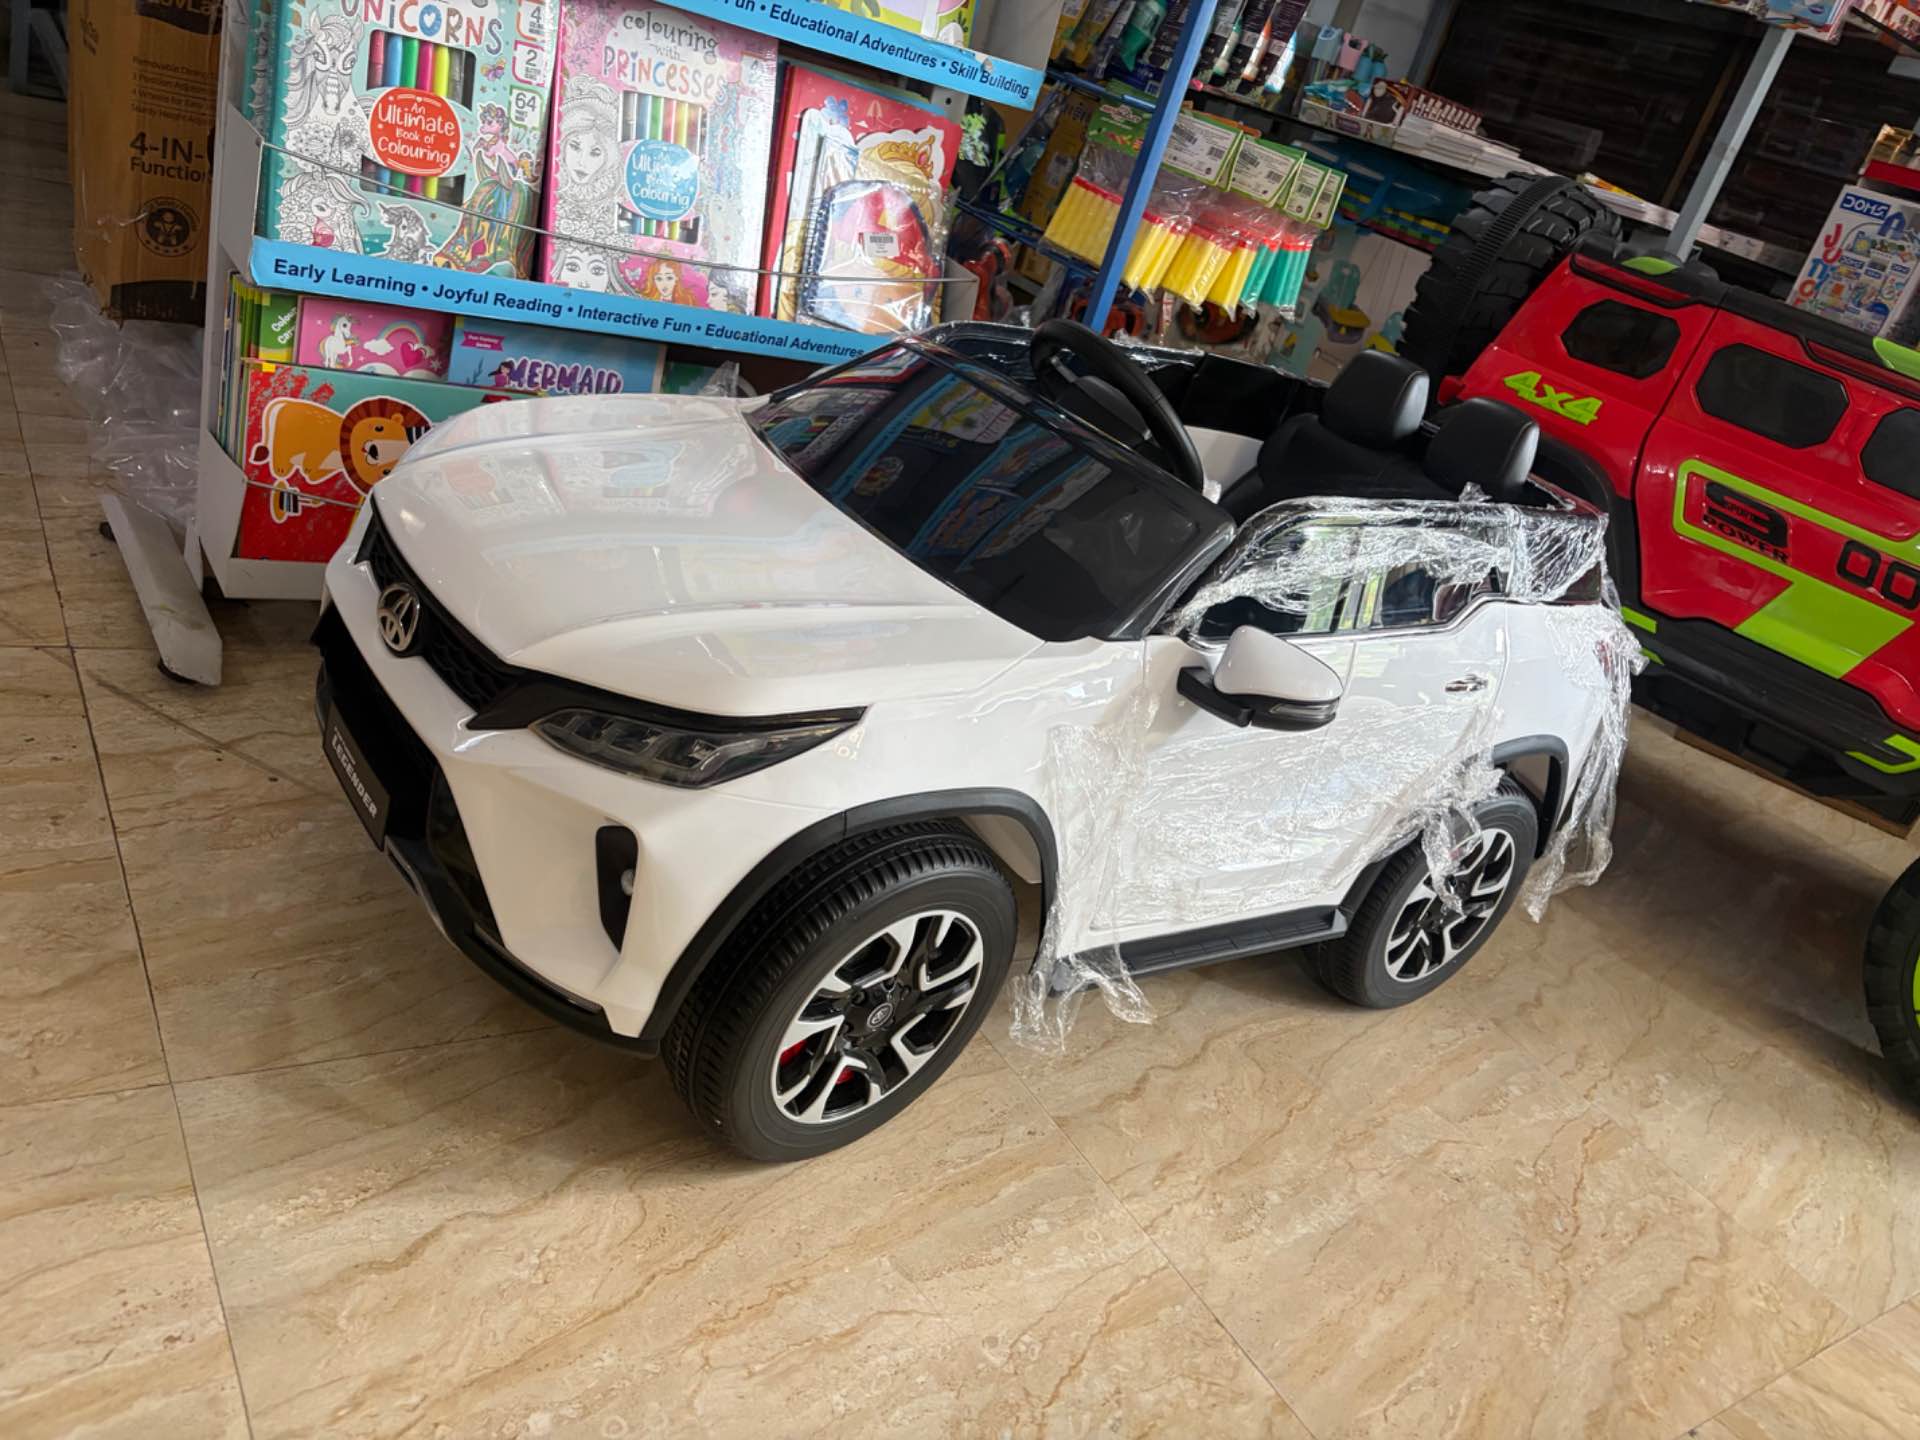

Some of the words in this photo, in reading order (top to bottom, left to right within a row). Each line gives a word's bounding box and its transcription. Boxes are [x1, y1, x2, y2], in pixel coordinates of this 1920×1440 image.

[530, 6, 542, 23] 4
[623, 11, 719, 63] colouring
[724, 0, 756, 12] un
[769, 5, 857, 44] Educational
[859, 33, 938, 69] Adventures
[948, 60, 978, 82] Skill
[980, 68, 1030, 99] Building
[526, 50, 538, 67] 2
[410, 102, 426, 114] An
[515, 92, 537, 112] 64
[377, 103, 456, 137] Ultimate
[395, 128, 421, 143] Book
[423, 133, 435, 145] of
[378, 136, 451, 168] Colouring
[273, 257, 325, 283] Early
[331, 267, 416, 297] Learning
[433, 283, 489, 306] Joyful
[493, 292, 563, 318] Reading
[577, 304, 659, 329] Interactive
[663, 316, 692, 334] Fun
[705, 323, 789, 348] Educational
[791, 336, 865, 358] Adventures
[508, 356, 623, 394] MERMAID
[1503, 371, 1603, 426] 4x4
